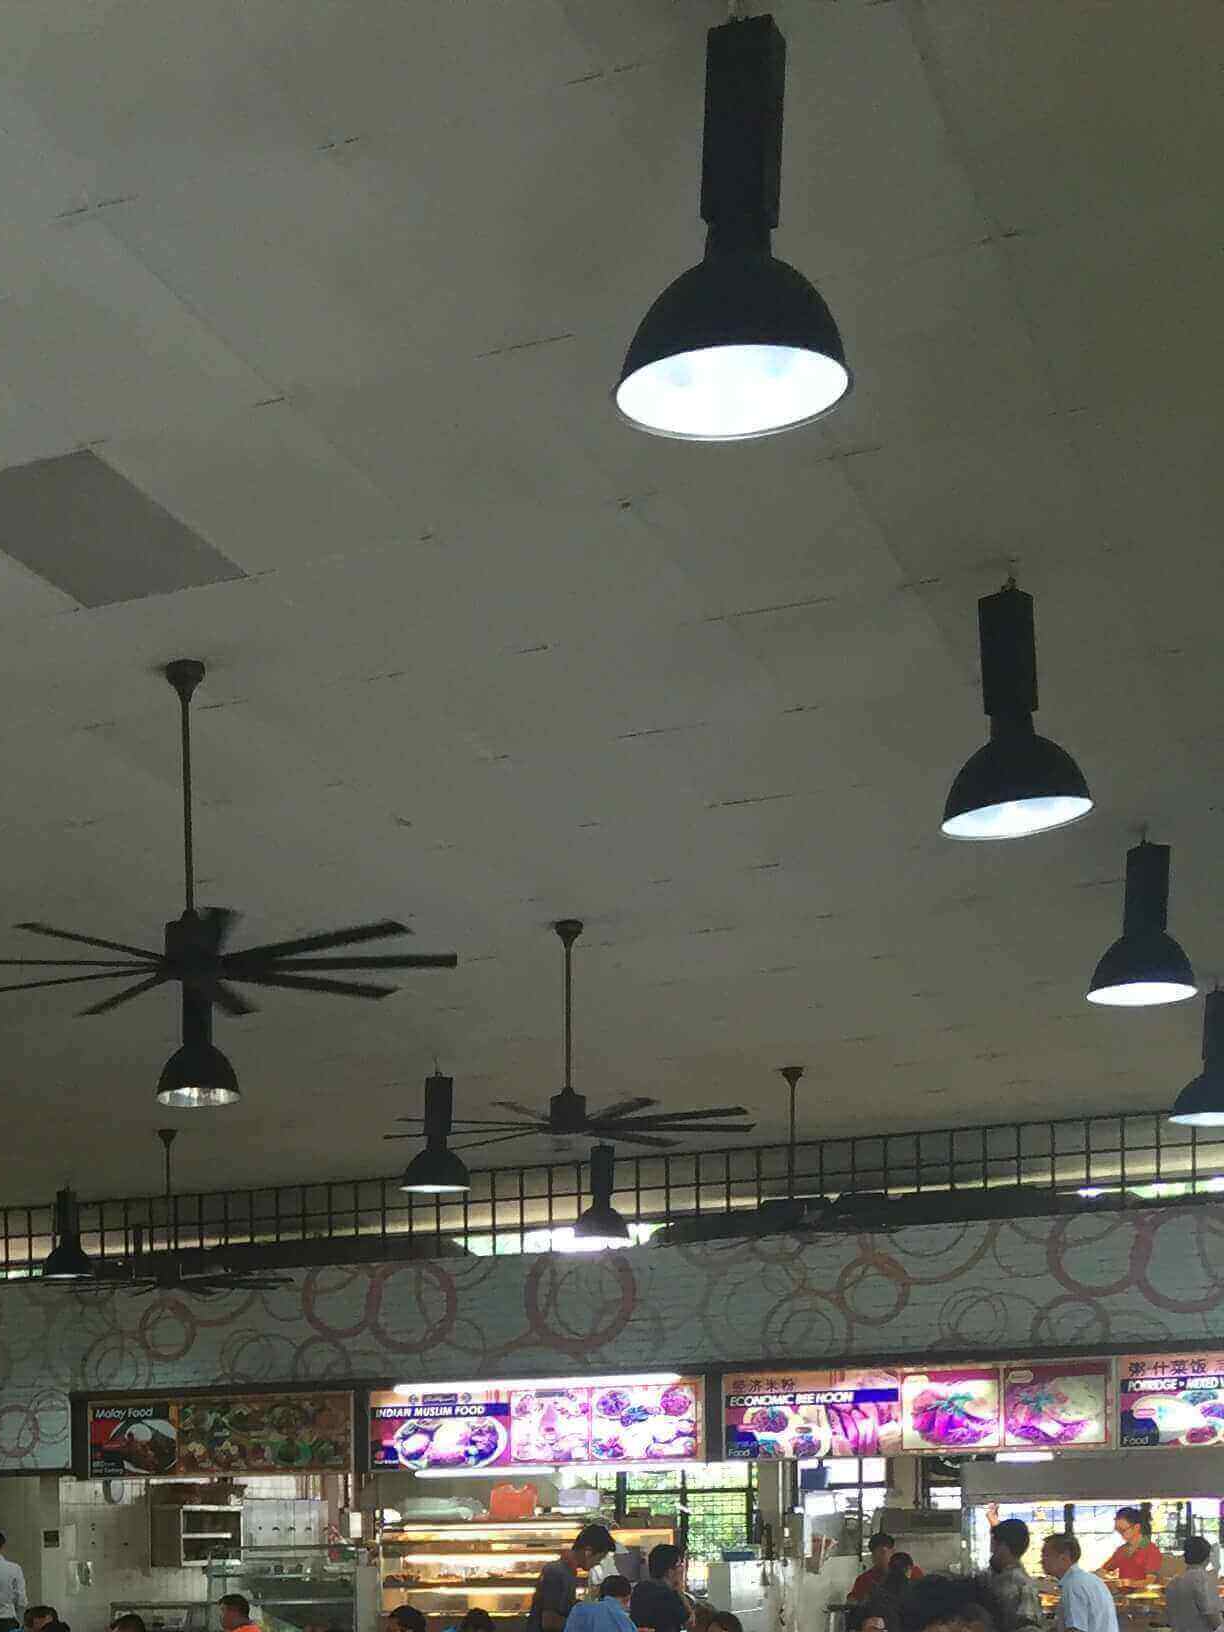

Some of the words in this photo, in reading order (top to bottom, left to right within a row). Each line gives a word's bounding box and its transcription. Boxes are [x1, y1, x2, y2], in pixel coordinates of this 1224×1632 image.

[730, 1394, 795, 1407] ECONOMIC
[795, 1393, 815, 1404] BEE
[816, 1391, 854, 1403] HOON
[95, 1408, 127, 1420] Malay
[127, 1407, 154, 1418] Food
[376, 1407, 411, 1418] INDIAN
[414, 1406, 453, 1417] MUSLIM
[455, 1405, 485, 1415] FOOD
[728, 1449, 751, 1457] Food
